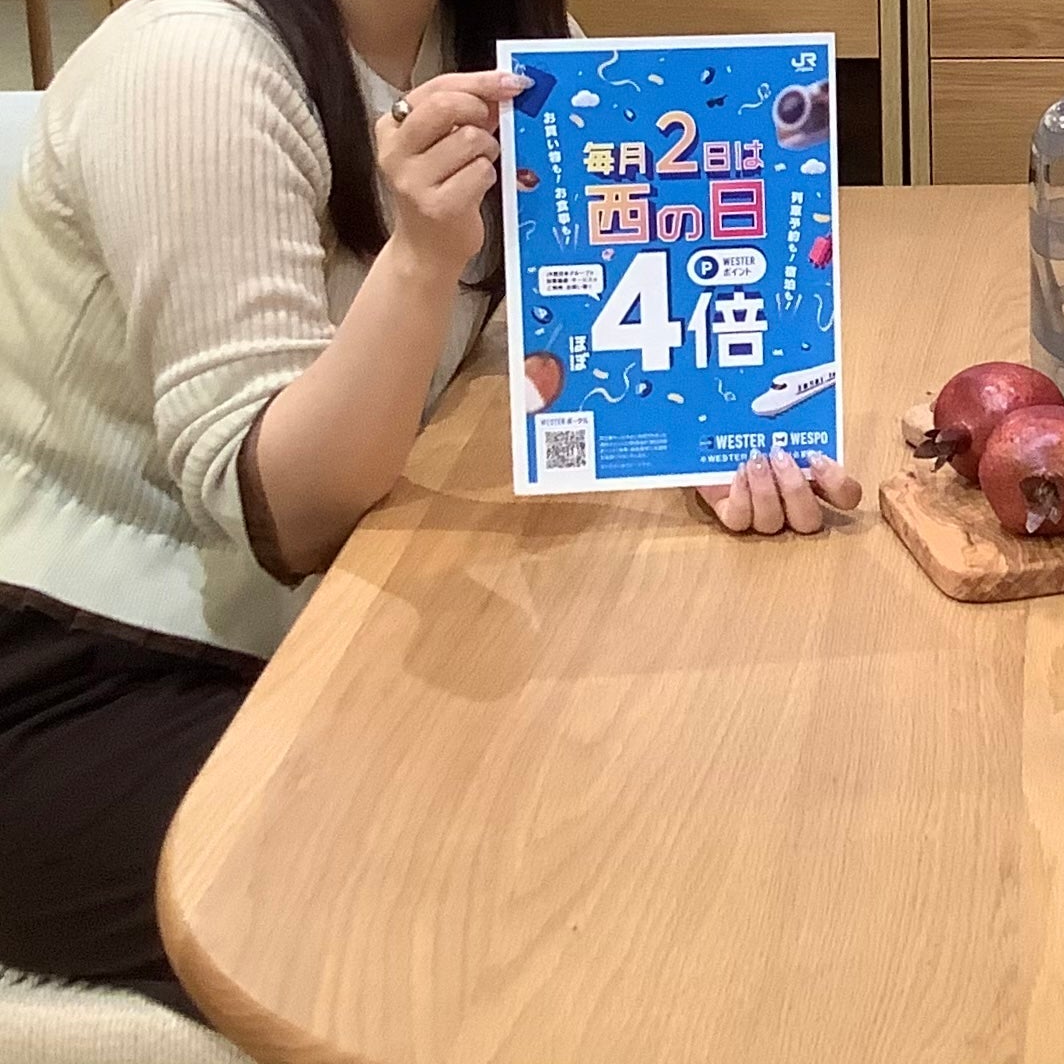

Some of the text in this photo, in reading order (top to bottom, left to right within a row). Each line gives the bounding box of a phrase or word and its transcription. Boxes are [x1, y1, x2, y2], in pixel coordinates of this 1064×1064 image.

[791, 52, 817, 67] JR
[583, 110, 765, 176] 毎月2日は
[585, 179, 767, 246] 西の日
[722, 256, 756, 266] WESTER
[723, 267, 752, 277] ポイント
[715, 433, 766, 450] WESTER
[789, 431, 829, 446] WESPO
